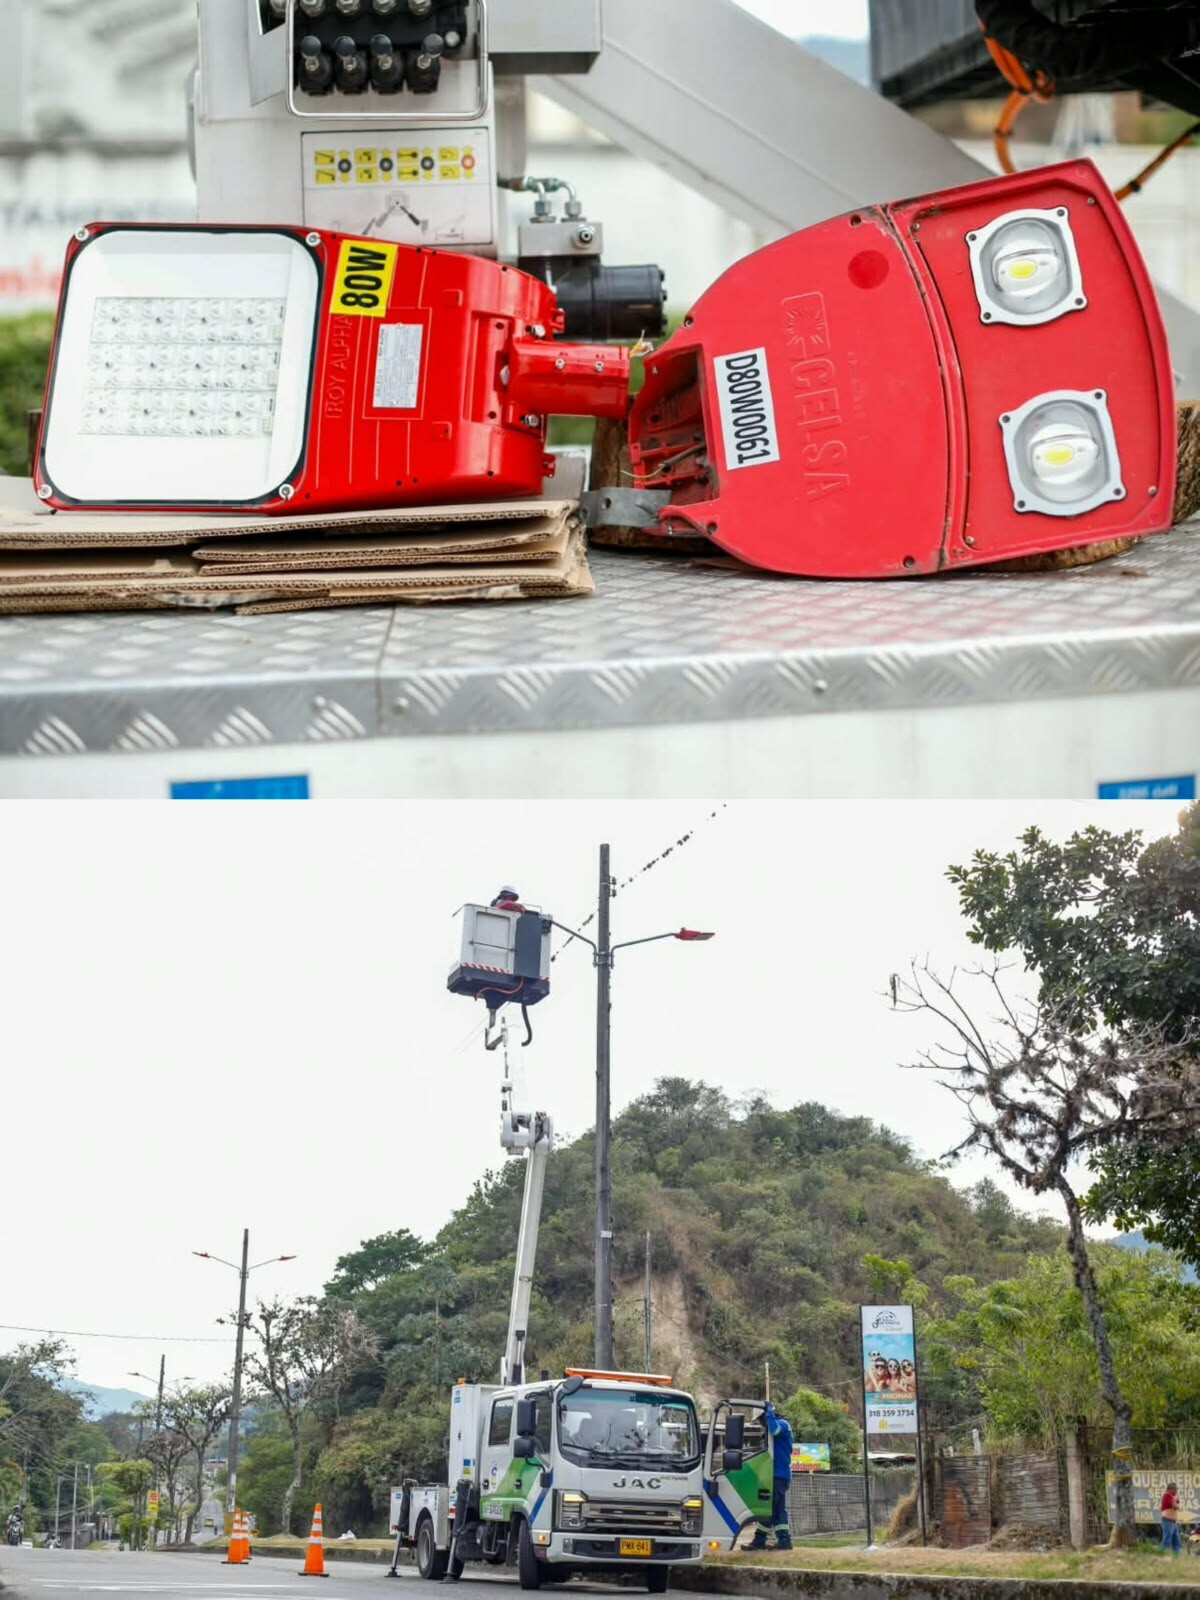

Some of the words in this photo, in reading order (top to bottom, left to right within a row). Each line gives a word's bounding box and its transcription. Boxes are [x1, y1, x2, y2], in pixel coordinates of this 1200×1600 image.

[340, 245, 388, 309] 80W
[725, 353, 771, 464] D80W0061
[790, 357, 852, 499] CELSA
[882, 1409, 896, 1417] 359
[612, 1477, 661, 1489] JAC
